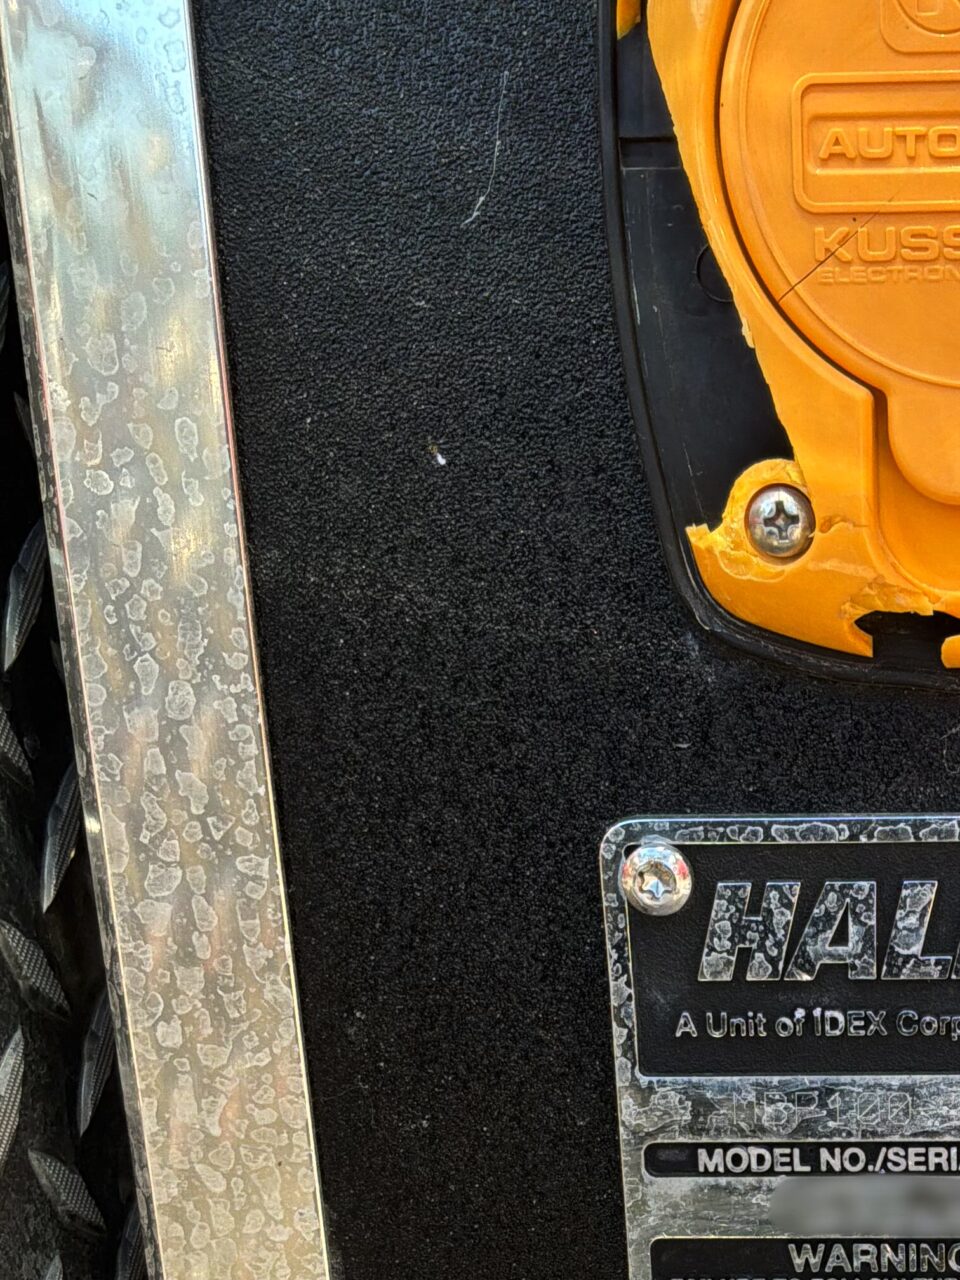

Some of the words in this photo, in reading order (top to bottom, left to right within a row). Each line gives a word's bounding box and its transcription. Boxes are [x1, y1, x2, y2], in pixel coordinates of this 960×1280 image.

[675, 1011, 697, 1037] A
[706, 1010, 767, 1037] Unit
[774, 1008, 805, 1037] of
[813, 1007, 887, 1036] IDEX
[698, 1148, 811, 1173] MODEL
